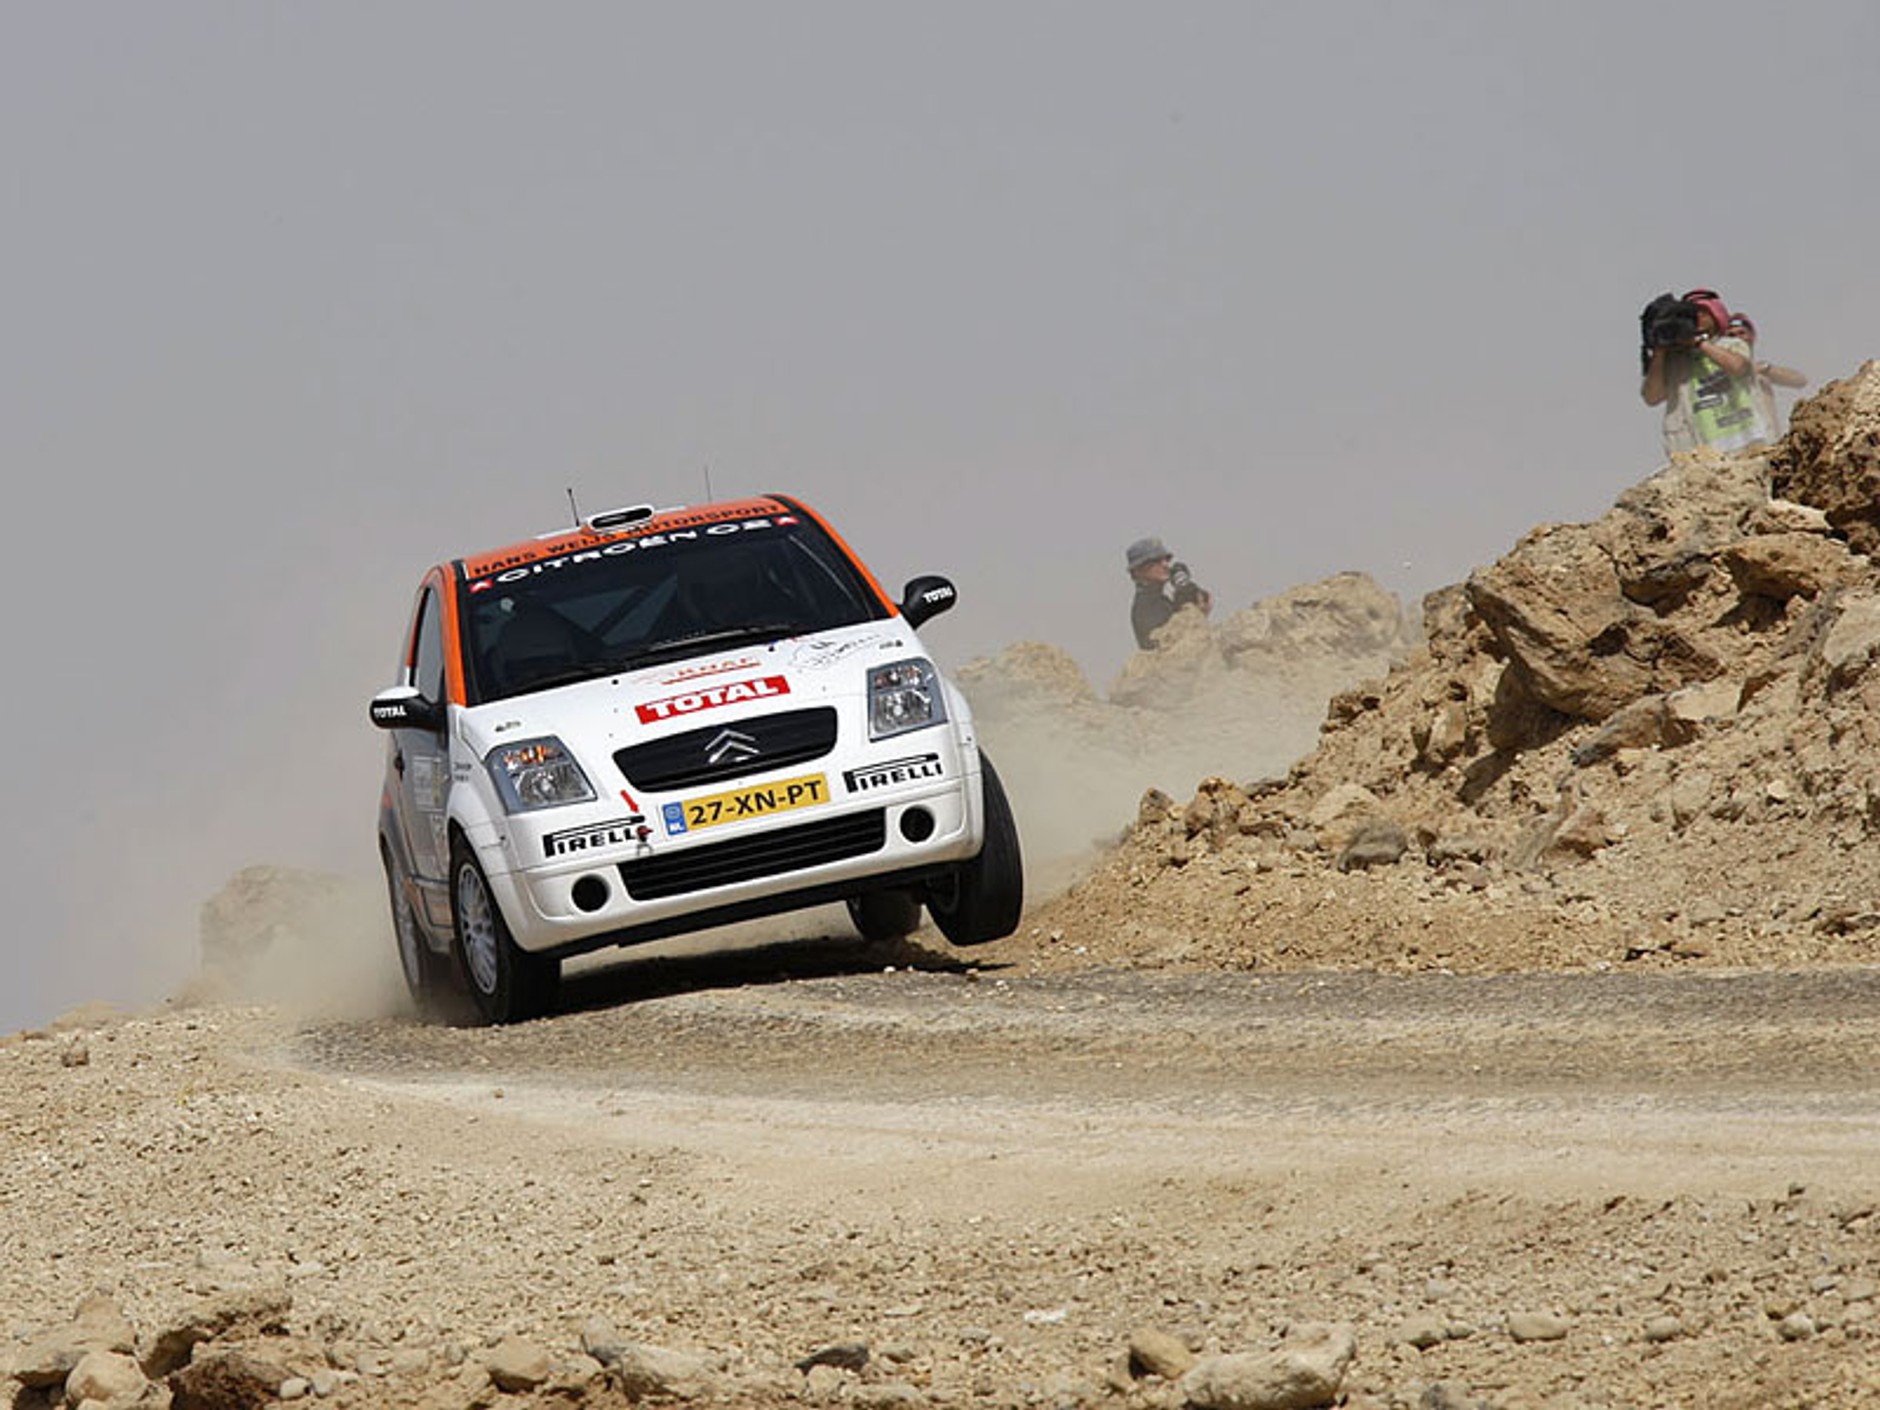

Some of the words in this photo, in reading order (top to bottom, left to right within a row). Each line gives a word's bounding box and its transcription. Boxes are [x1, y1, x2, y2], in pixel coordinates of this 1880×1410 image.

[474, 552, 537, 575] HANS
[626, 504, 780, 535] MOTORSPORT
[374, 705, 407, 719] TOTAL
[646, 677, 780, 717] TOTAL
[842, 752, 943, 793] PIRELLI
[688, 779, 822, 826] 27-XN-PT
[542, 815, 646, 858] PIRELL
